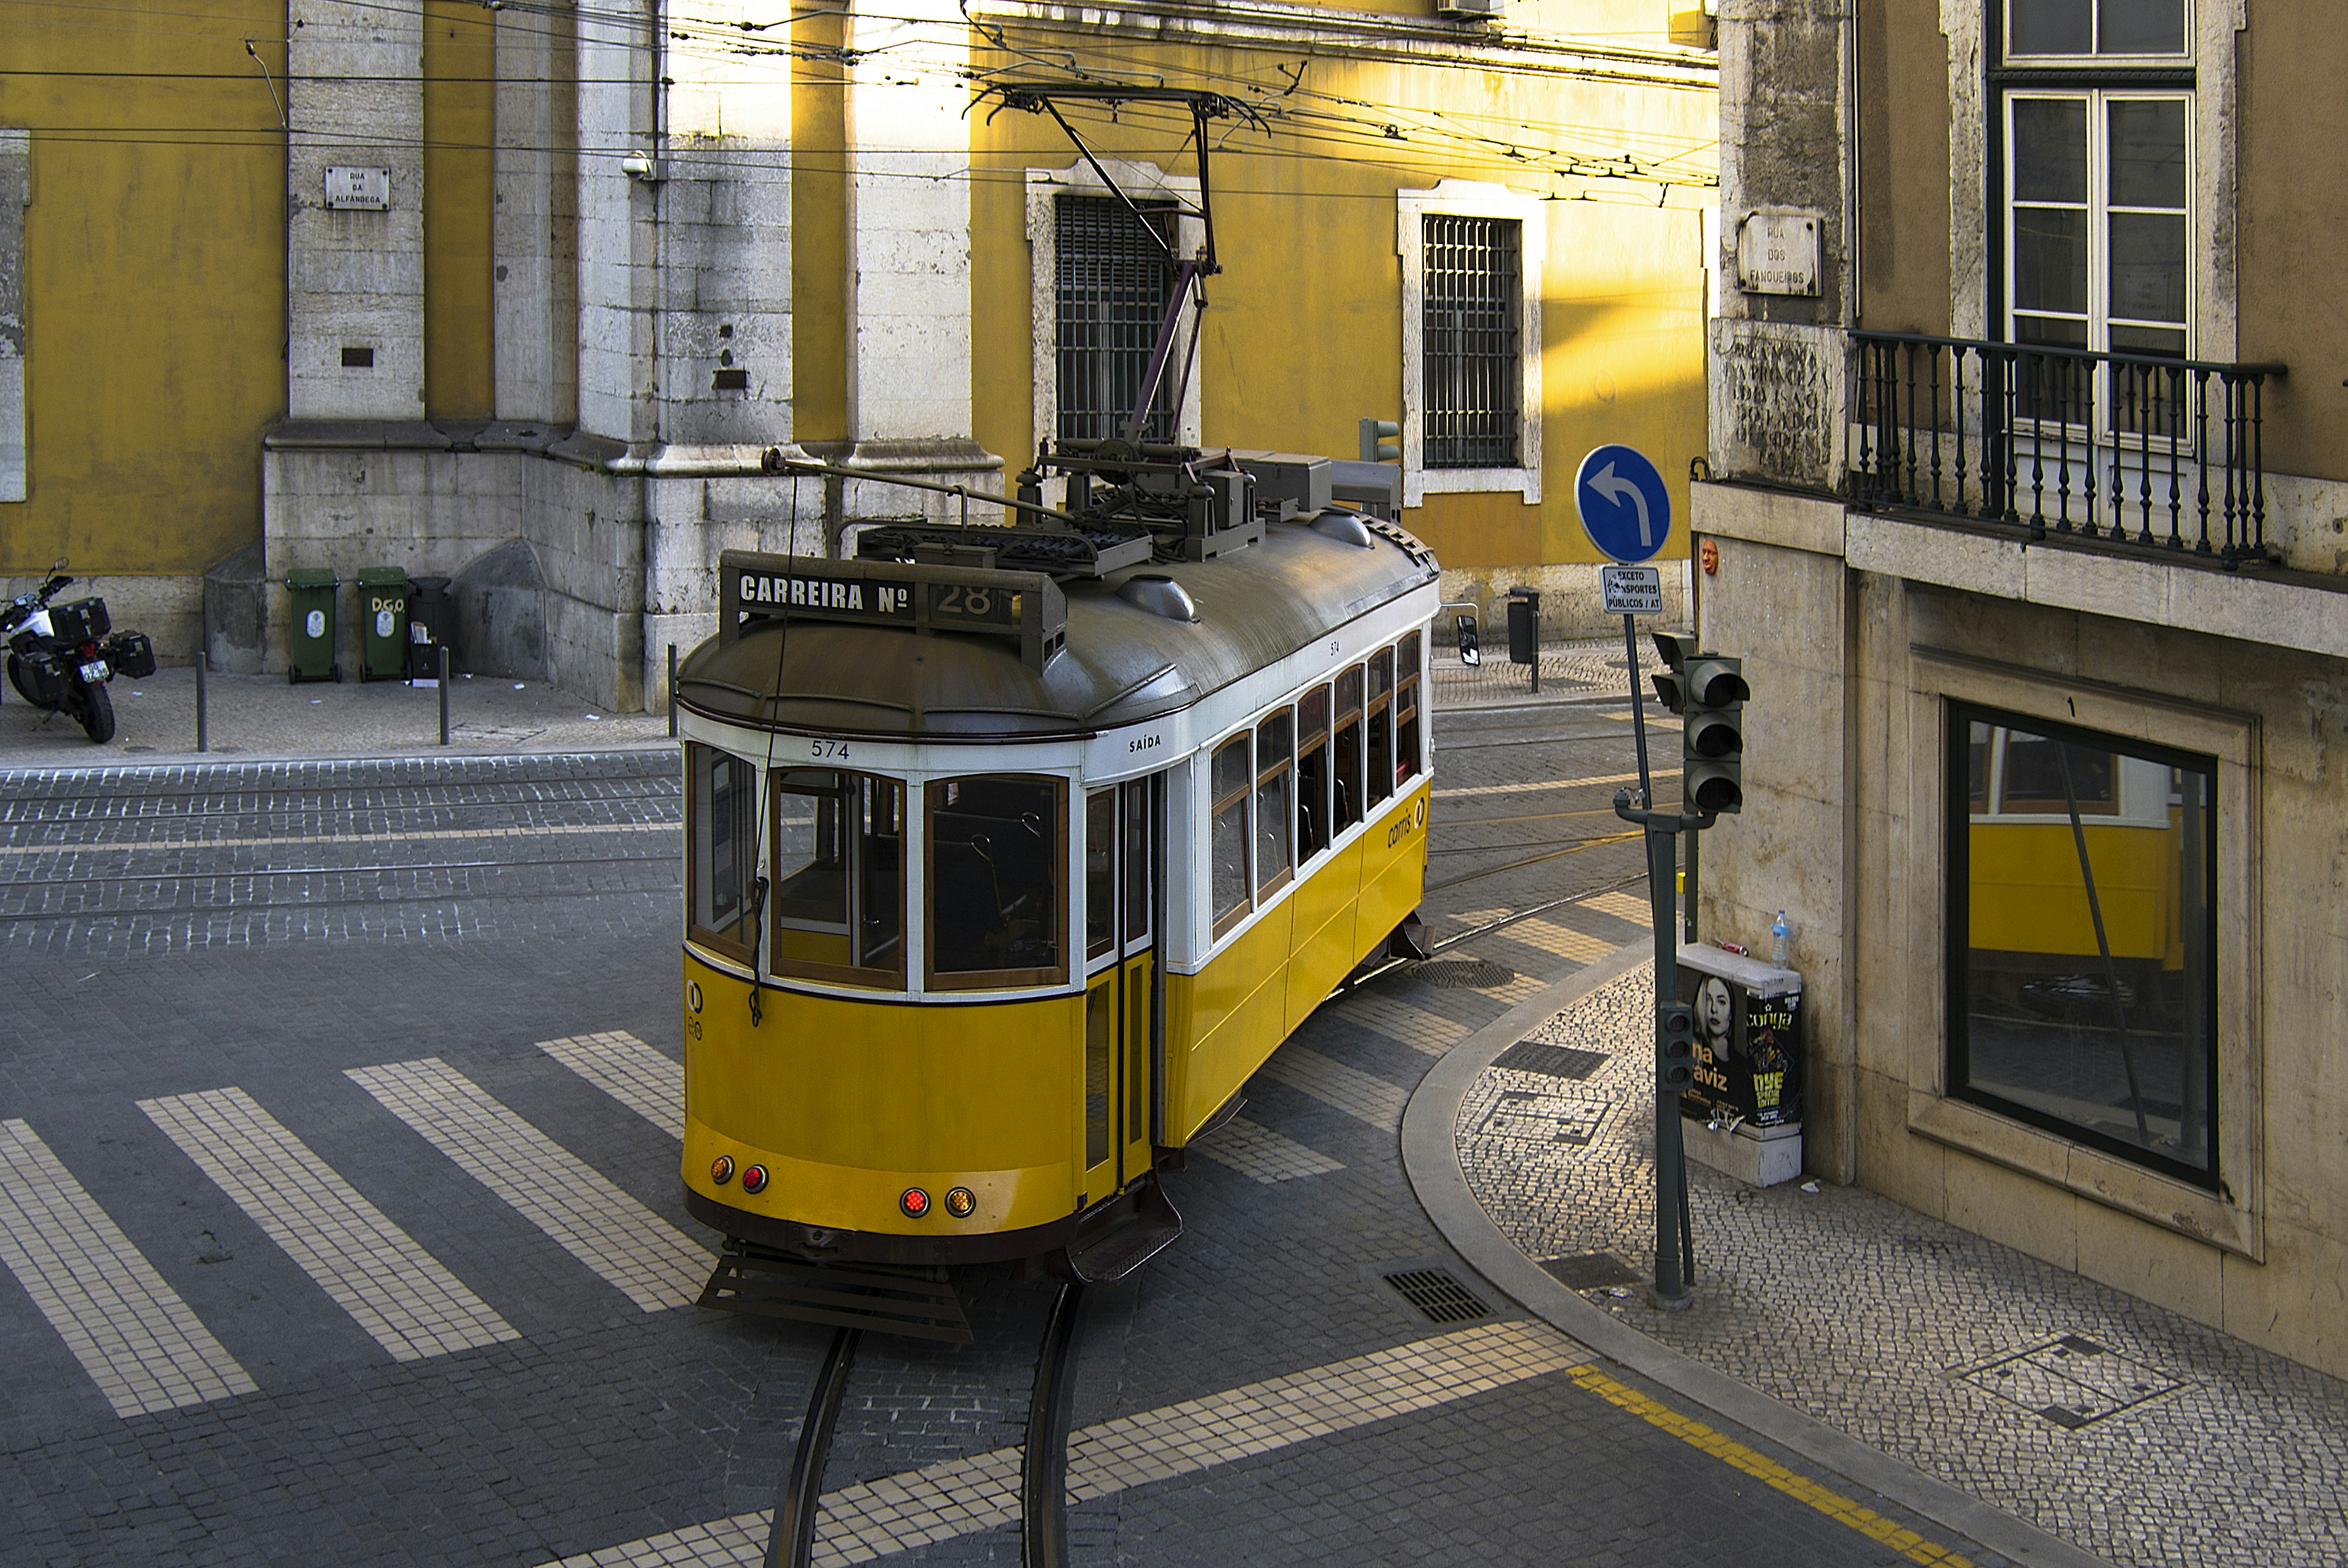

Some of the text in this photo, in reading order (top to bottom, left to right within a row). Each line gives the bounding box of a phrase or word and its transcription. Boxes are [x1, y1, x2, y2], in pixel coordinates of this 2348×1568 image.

[1767, 227, 1784, 239] RUA
[1768, 249, 1785, 261] DOS
[1618, 571, 1644, 580] EXCETO
[740, 575, 864, 610] CARREIRA
[938, 586, 991, 615] 28
[1608, 584, 1657, 594] NSPORTES
[1608, 596, 1643, 608] PÚBLICOS
[1651, 599, 1659, 608] AT
[1330, 641, 1339, 656] 574
[811, 741, 849, 759] 574
[1129, 734, 1161, 753] SAÍDA
[1388, 808, 1411, 849] carris
[1692, 1043, 1713, 1065] na
[1693, 1065, 1727, 1092] aviz
